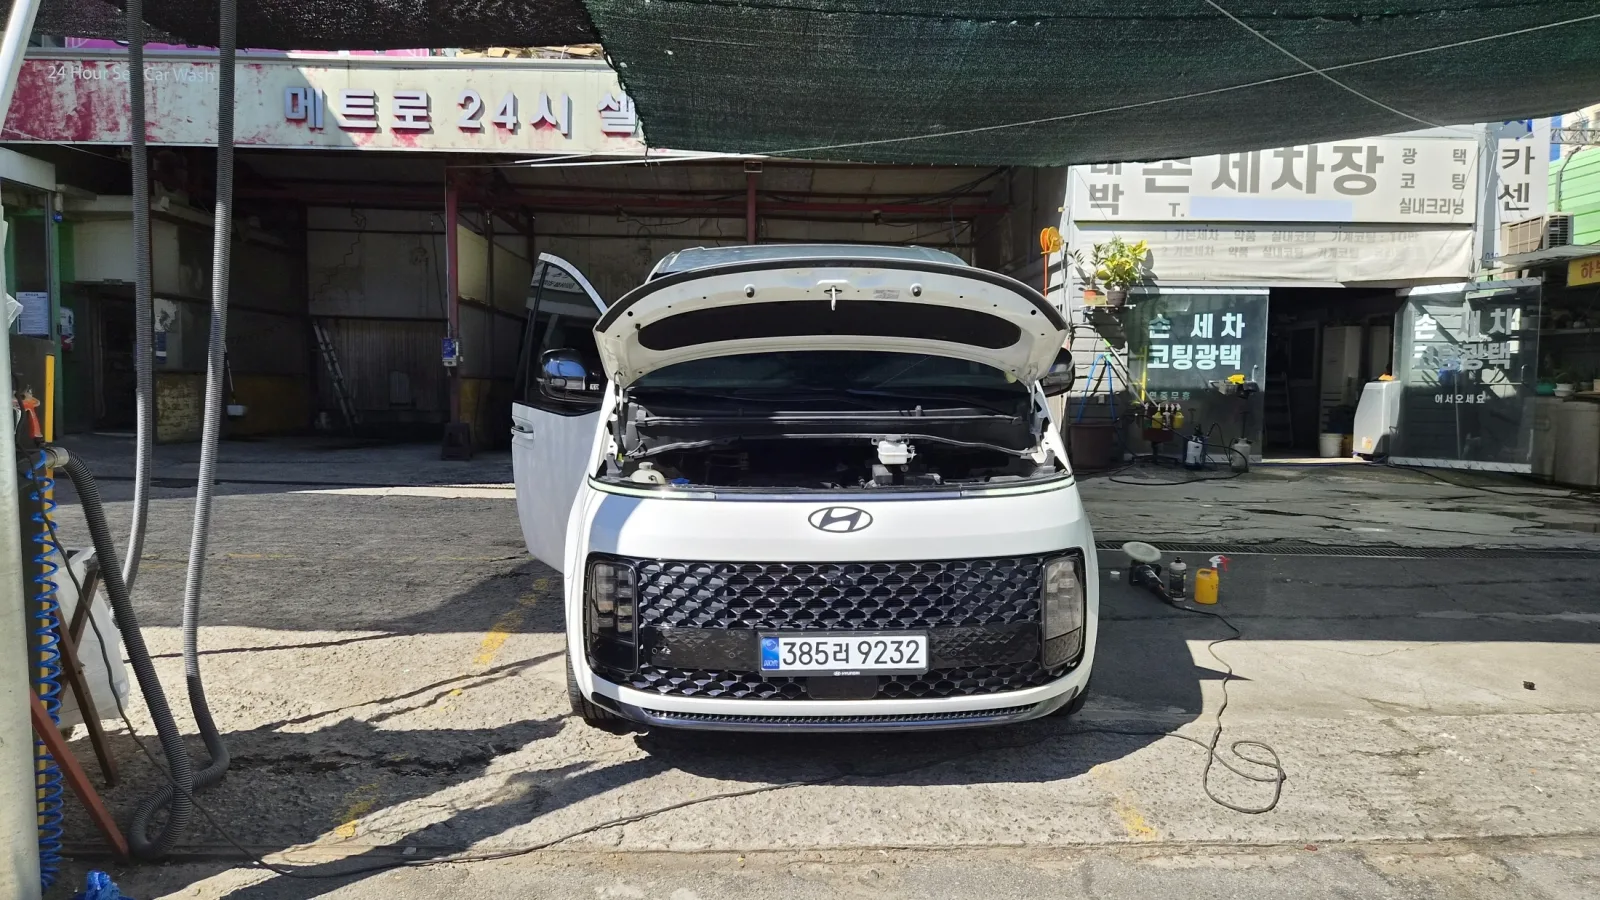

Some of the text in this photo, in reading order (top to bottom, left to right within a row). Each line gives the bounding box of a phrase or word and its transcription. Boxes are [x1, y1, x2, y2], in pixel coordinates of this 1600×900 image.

[48, 66, 66, 79] 24
[70, 66, 107, 80] Hour
[145, 67, 170, 81] Car
[173, 68, 214, 82] Wash
[285, 87, 431, 129] 메트로
[457, 89, 568, 134] 24시
[1399, 198, 1465, 215] 실내크리닝
[1149, 313, 1246, 338] 손 세차
[1414, 308, 1516, 340] 손 세차
[1147, 344, 1242, 370] 코팅광택
[1434, 394, 1485, 404] 어서오세요
[782, 640, 920, 666] 385러 9232
